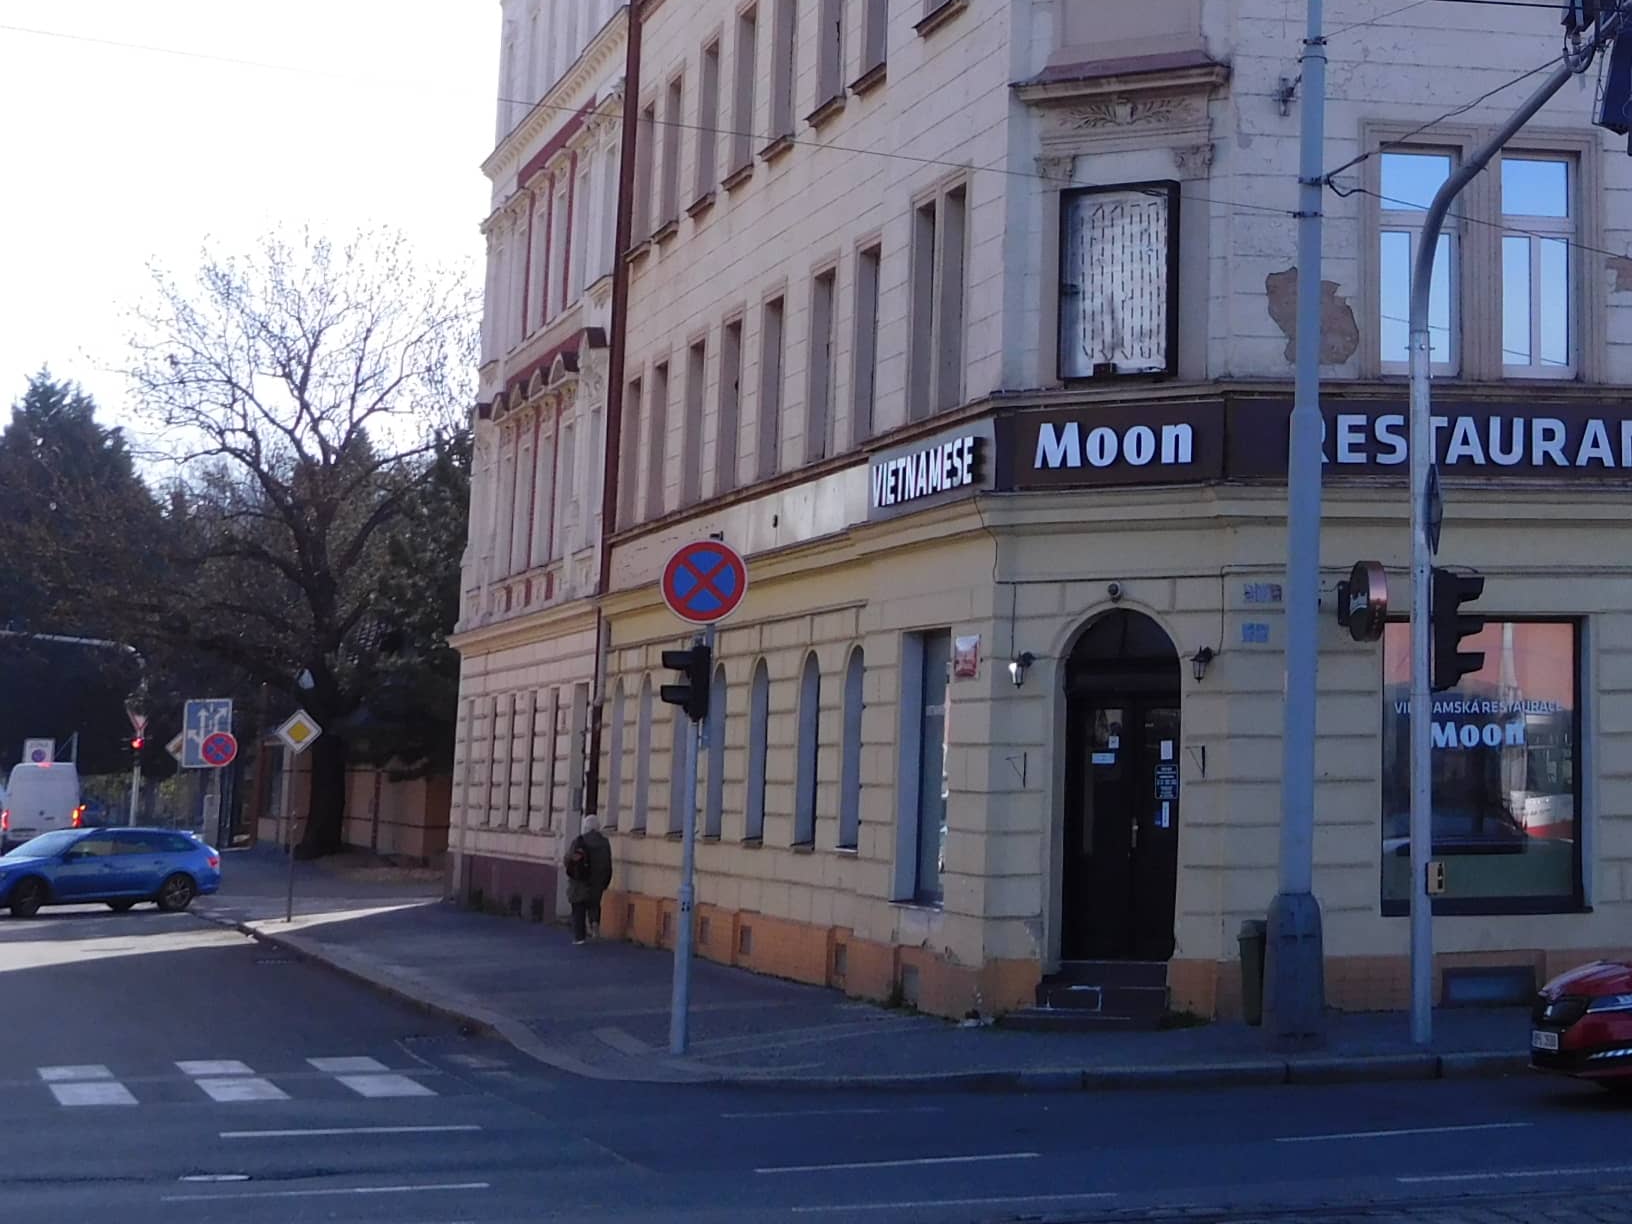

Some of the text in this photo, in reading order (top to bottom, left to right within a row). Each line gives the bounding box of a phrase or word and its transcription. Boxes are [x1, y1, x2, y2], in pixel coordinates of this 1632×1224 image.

[1033, 421, 1194, 469] Moon
[872, 435, 975, 508] VIETNAMESE
[1394, 698, 1563, 714] VIAMSKÁ RESTAURACE
[1431, 721, 1525, 748] Moon
